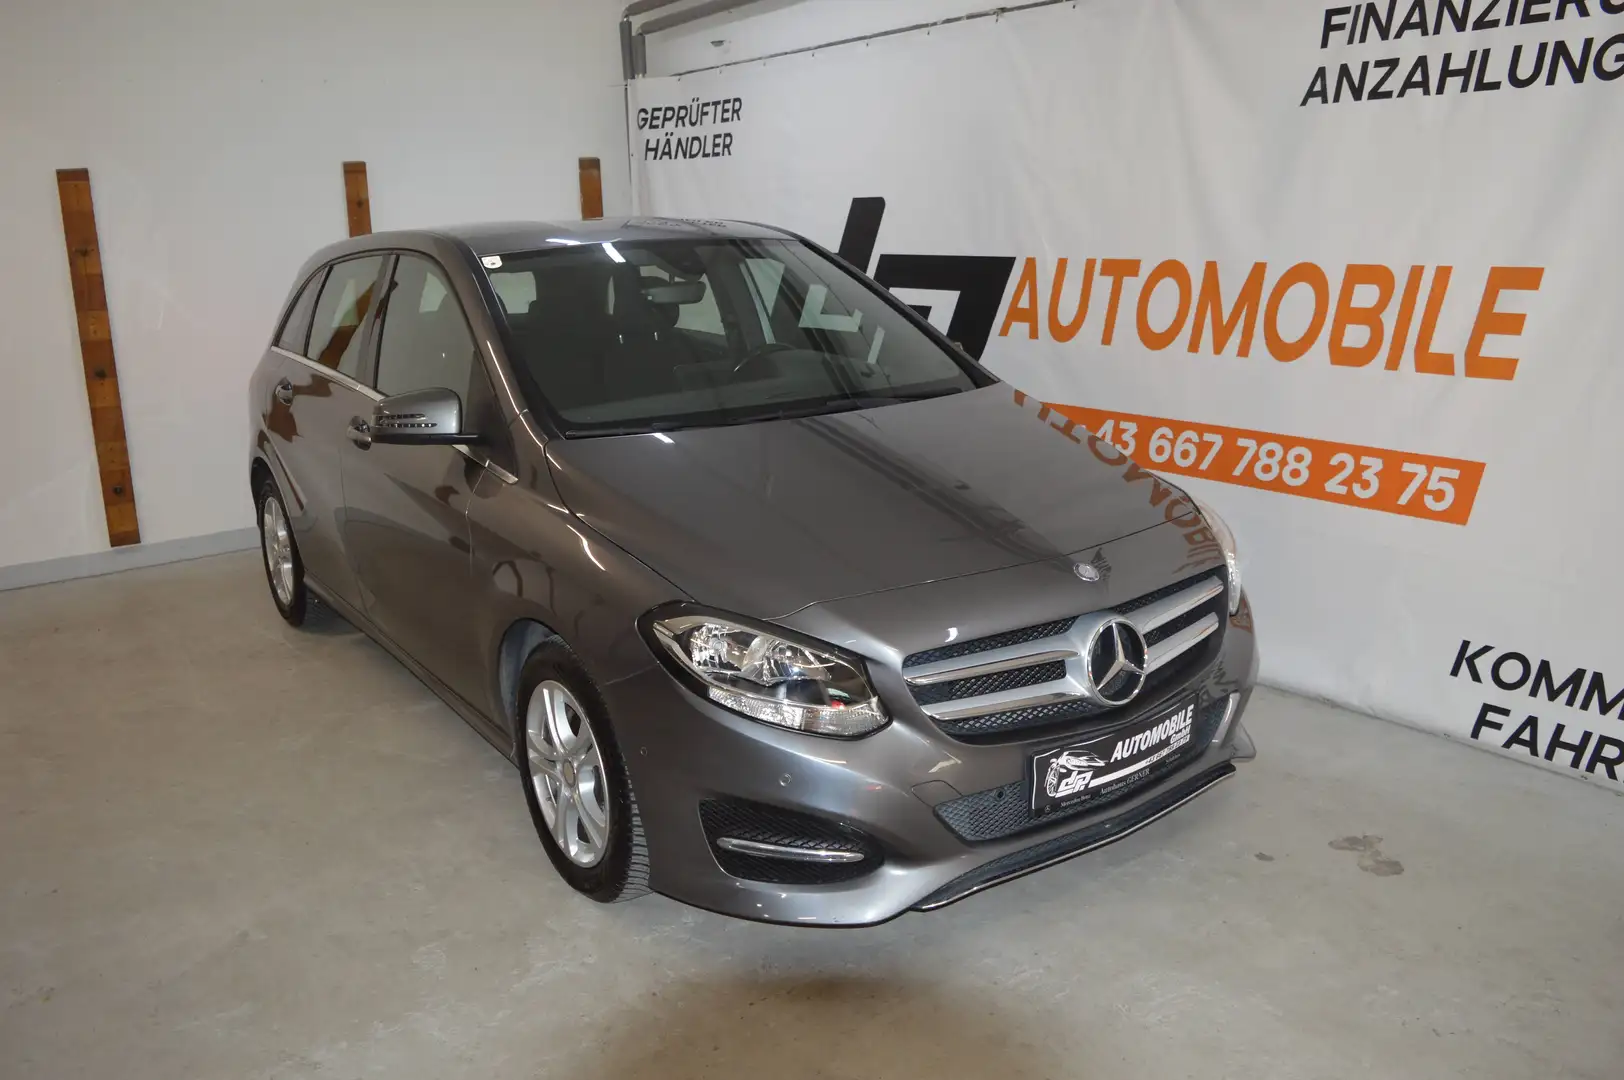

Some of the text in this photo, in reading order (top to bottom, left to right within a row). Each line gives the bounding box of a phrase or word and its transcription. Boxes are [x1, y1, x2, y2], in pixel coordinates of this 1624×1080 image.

[1300, 33, 1624, 107] ANZAHLUNG
[637, 97, 742, 130] GEPRÜFTER
[645, 132, 733, 160] HÄNDLER
[1000, 257, 1544, 380] AUTOMOBILE
[1149, 426, 1223, 470] 667
[1232, 438, 1312, 486] 788
[1325, 452, 1383, 498] 23
[1397, 463, 1460, 511] 75
[1450, 640, 1624, 720] KOMM
[1110, 703, 1194, 762] AUTOMOBILE
[1470, 703, 1624, 782] FAHR
[1100, 780, 1127, 795] Autohaus
